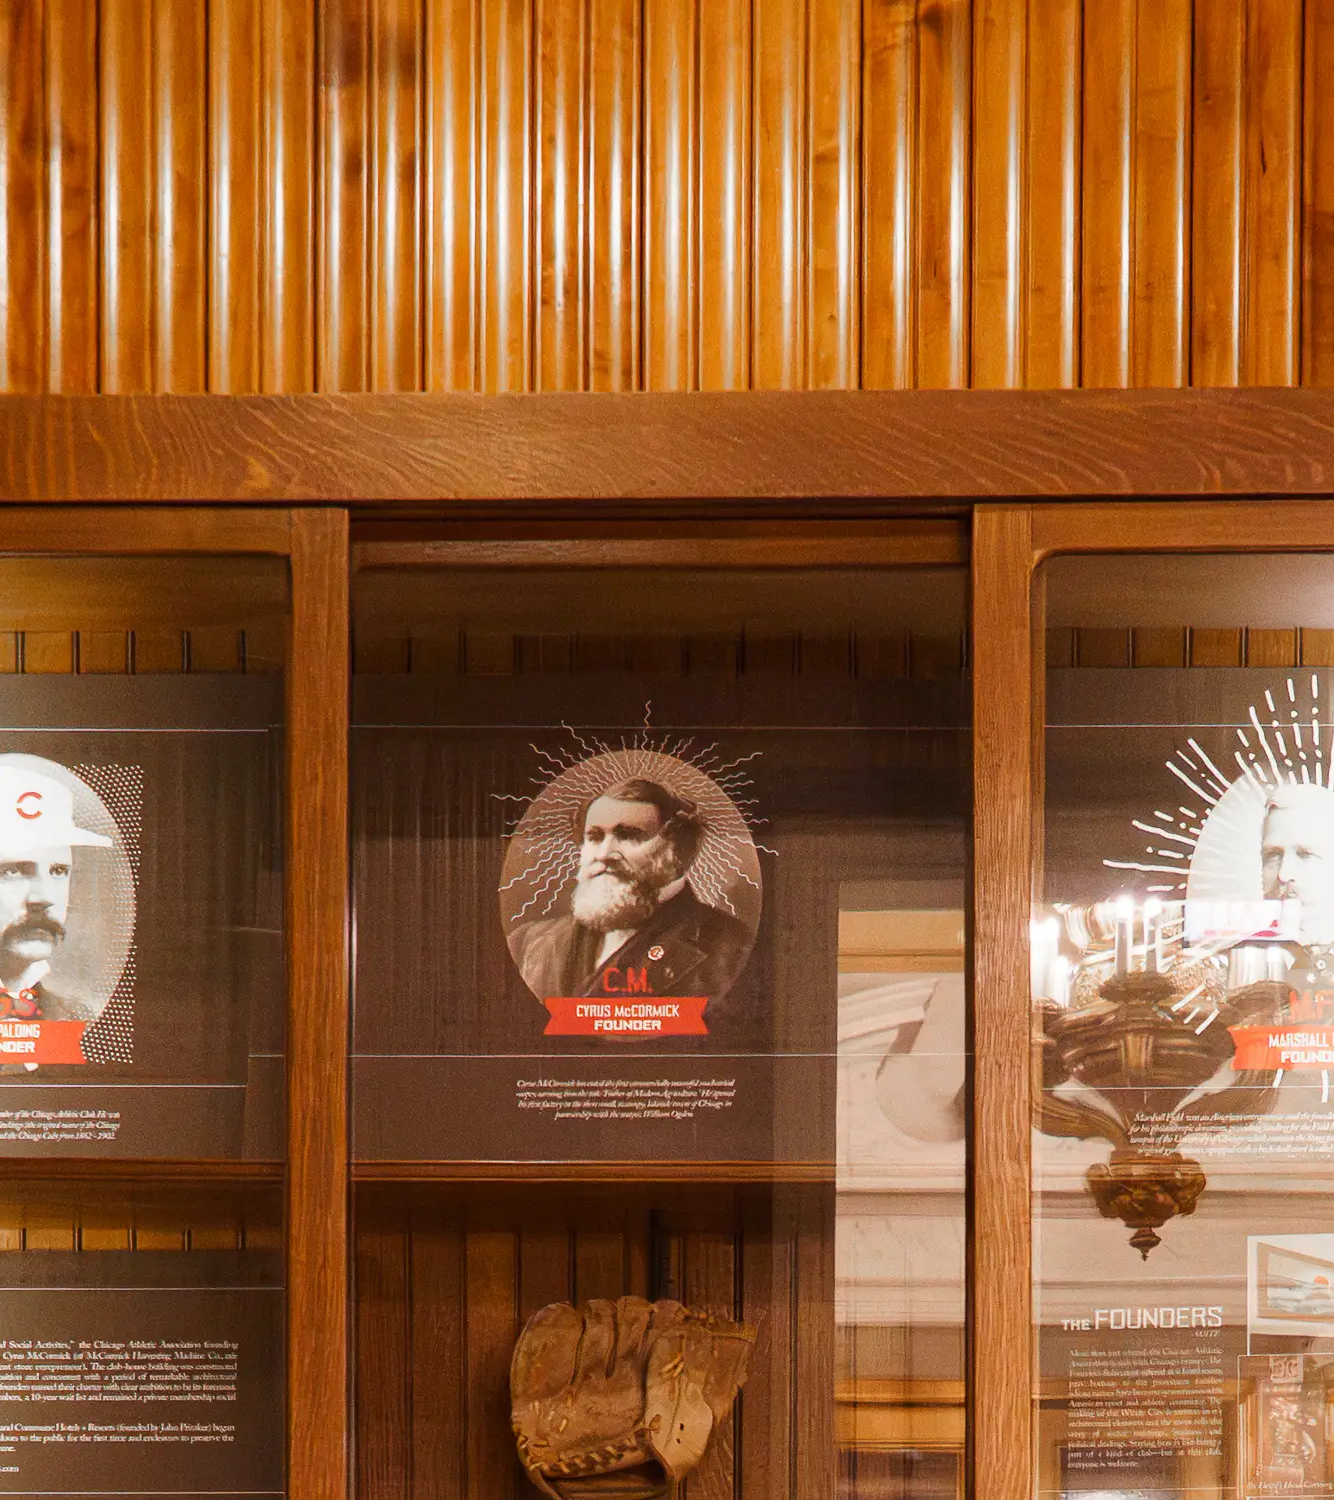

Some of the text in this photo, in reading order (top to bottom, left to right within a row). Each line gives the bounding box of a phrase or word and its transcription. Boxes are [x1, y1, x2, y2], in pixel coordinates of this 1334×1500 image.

[602, 966, 654, 993] C.M.
[576, 1004, 680, 1018] CYRUS McCORMICK
[593, 1020, 662, 1031] FOUNDER
[1268, 1032, 1329, 1048] MARSHALL
[1061, 1306, 1224, 1331] THE FOUNDERS
